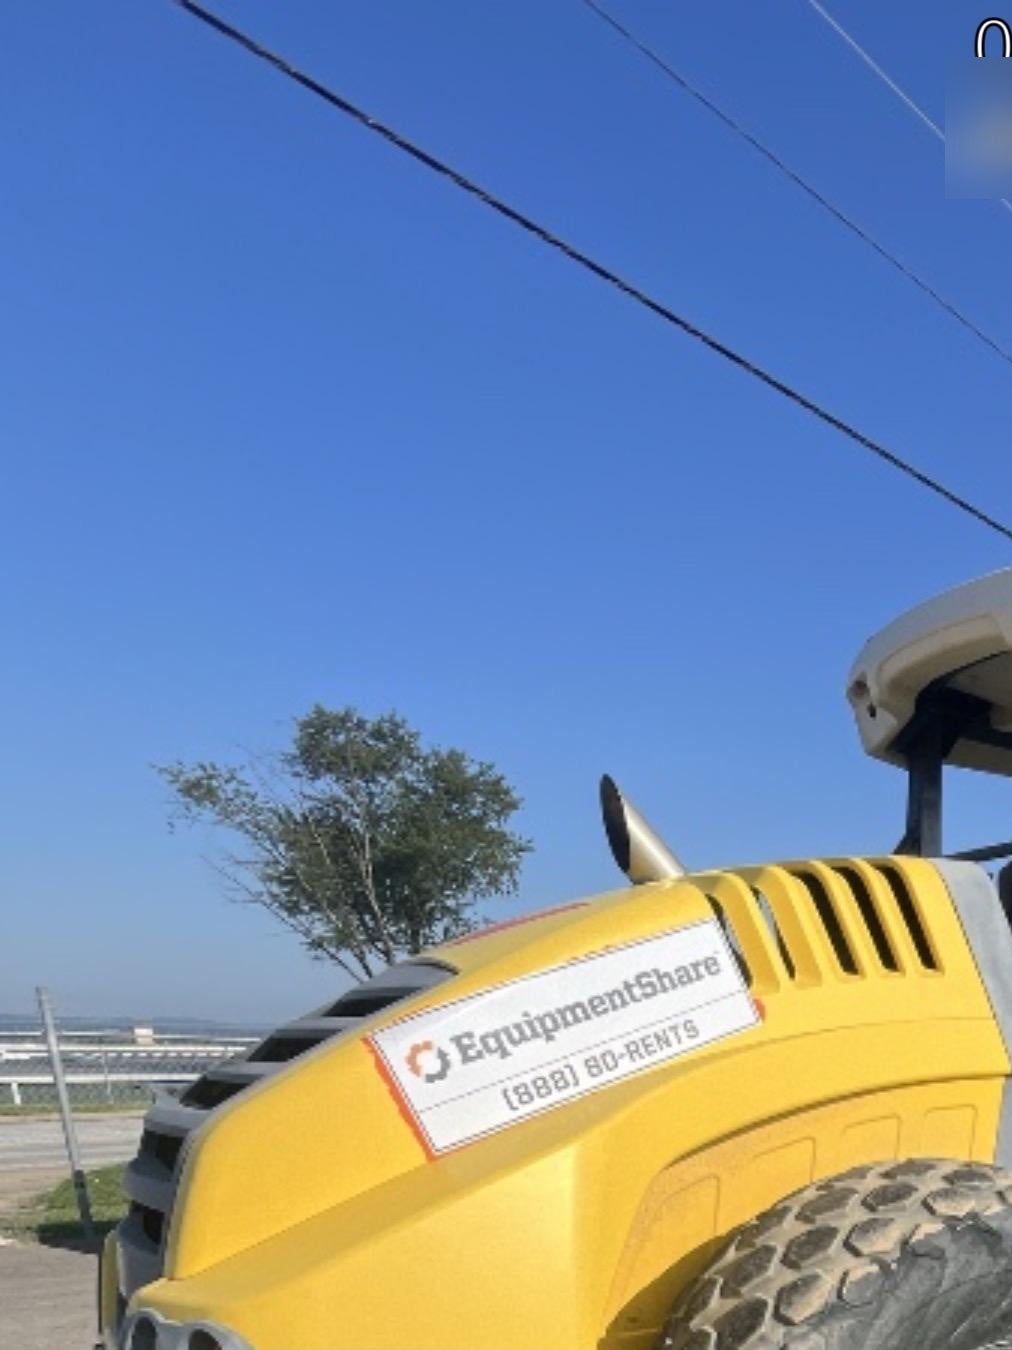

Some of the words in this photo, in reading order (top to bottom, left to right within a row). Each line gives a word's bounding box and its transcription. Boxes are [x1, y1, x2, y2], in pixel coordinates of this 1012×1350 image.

[450, 956, 721, 1064] EquipmentShare
[502, 1064, 580, 1111] (888)
[583, 1018, 700, 1079] 80-RENTS
